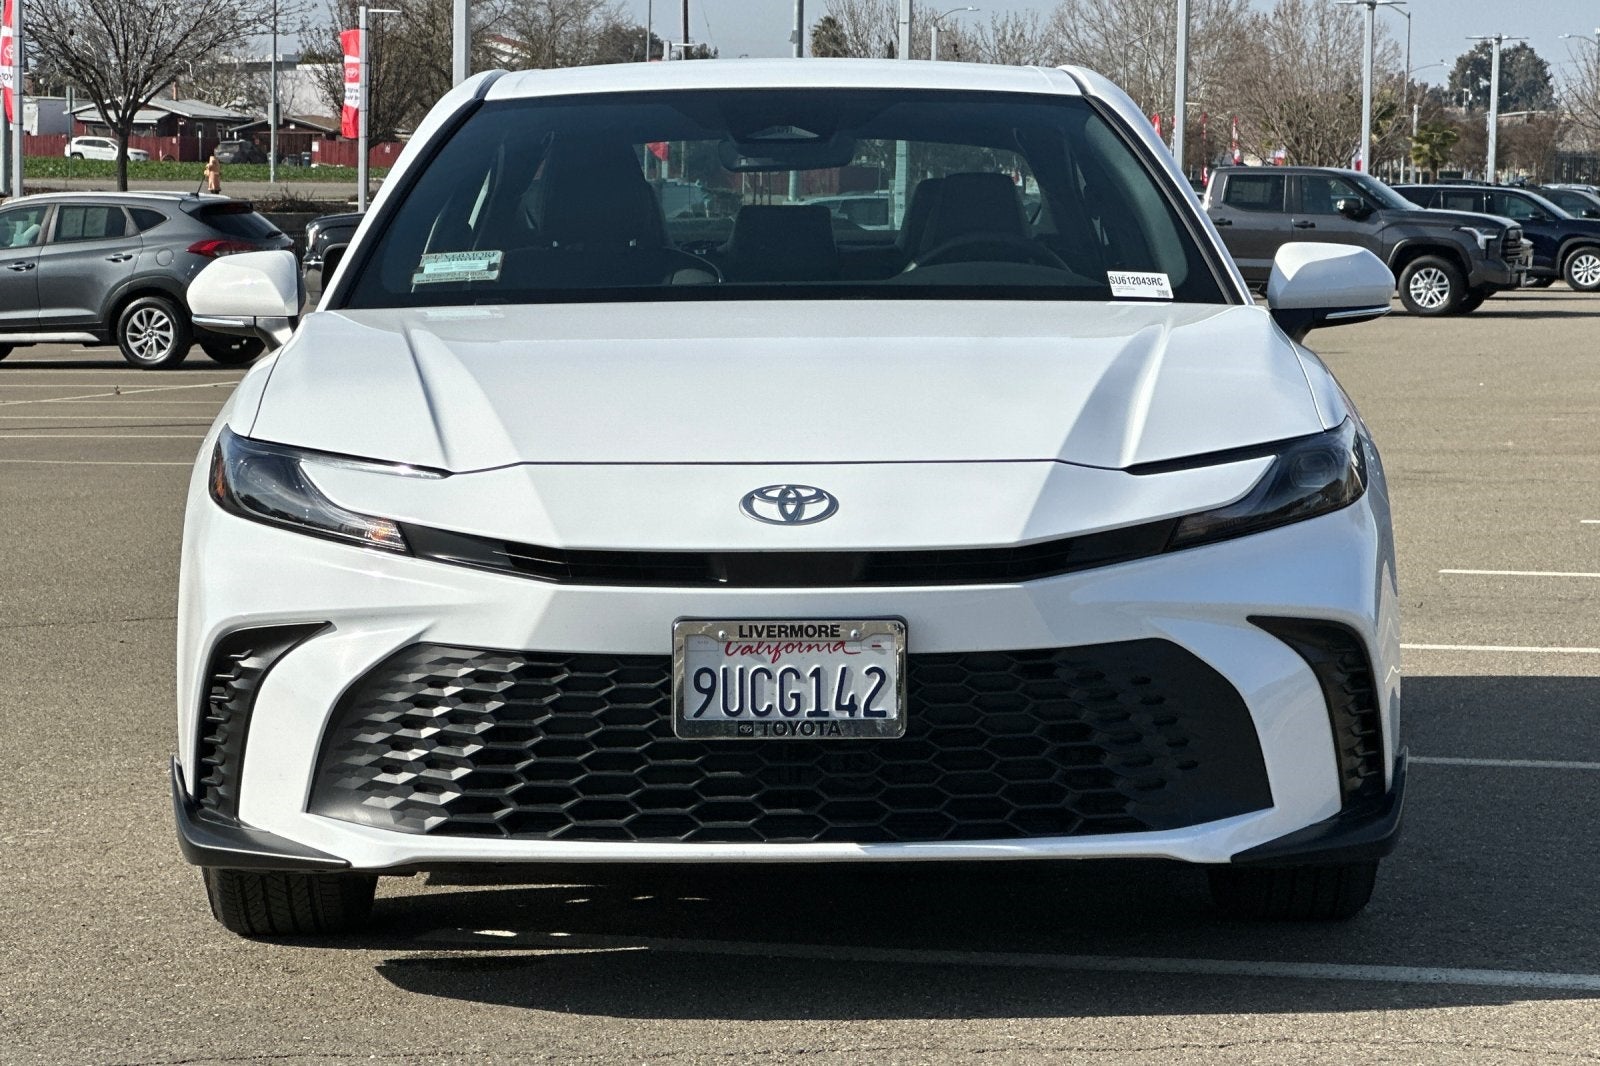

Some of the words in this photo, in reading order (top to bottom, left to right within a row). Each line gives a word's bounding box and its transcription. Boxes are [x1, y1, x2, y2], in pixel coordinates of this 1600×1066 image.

[1109, 275, 1163, 286] SU612043RC
[738, 624, 841, 639] LIVERMORE
[725, 641, 861, 663] California
[692, 666, 887, 718] 9UCG142
[760, 721, 842, 737] TOYOTA
